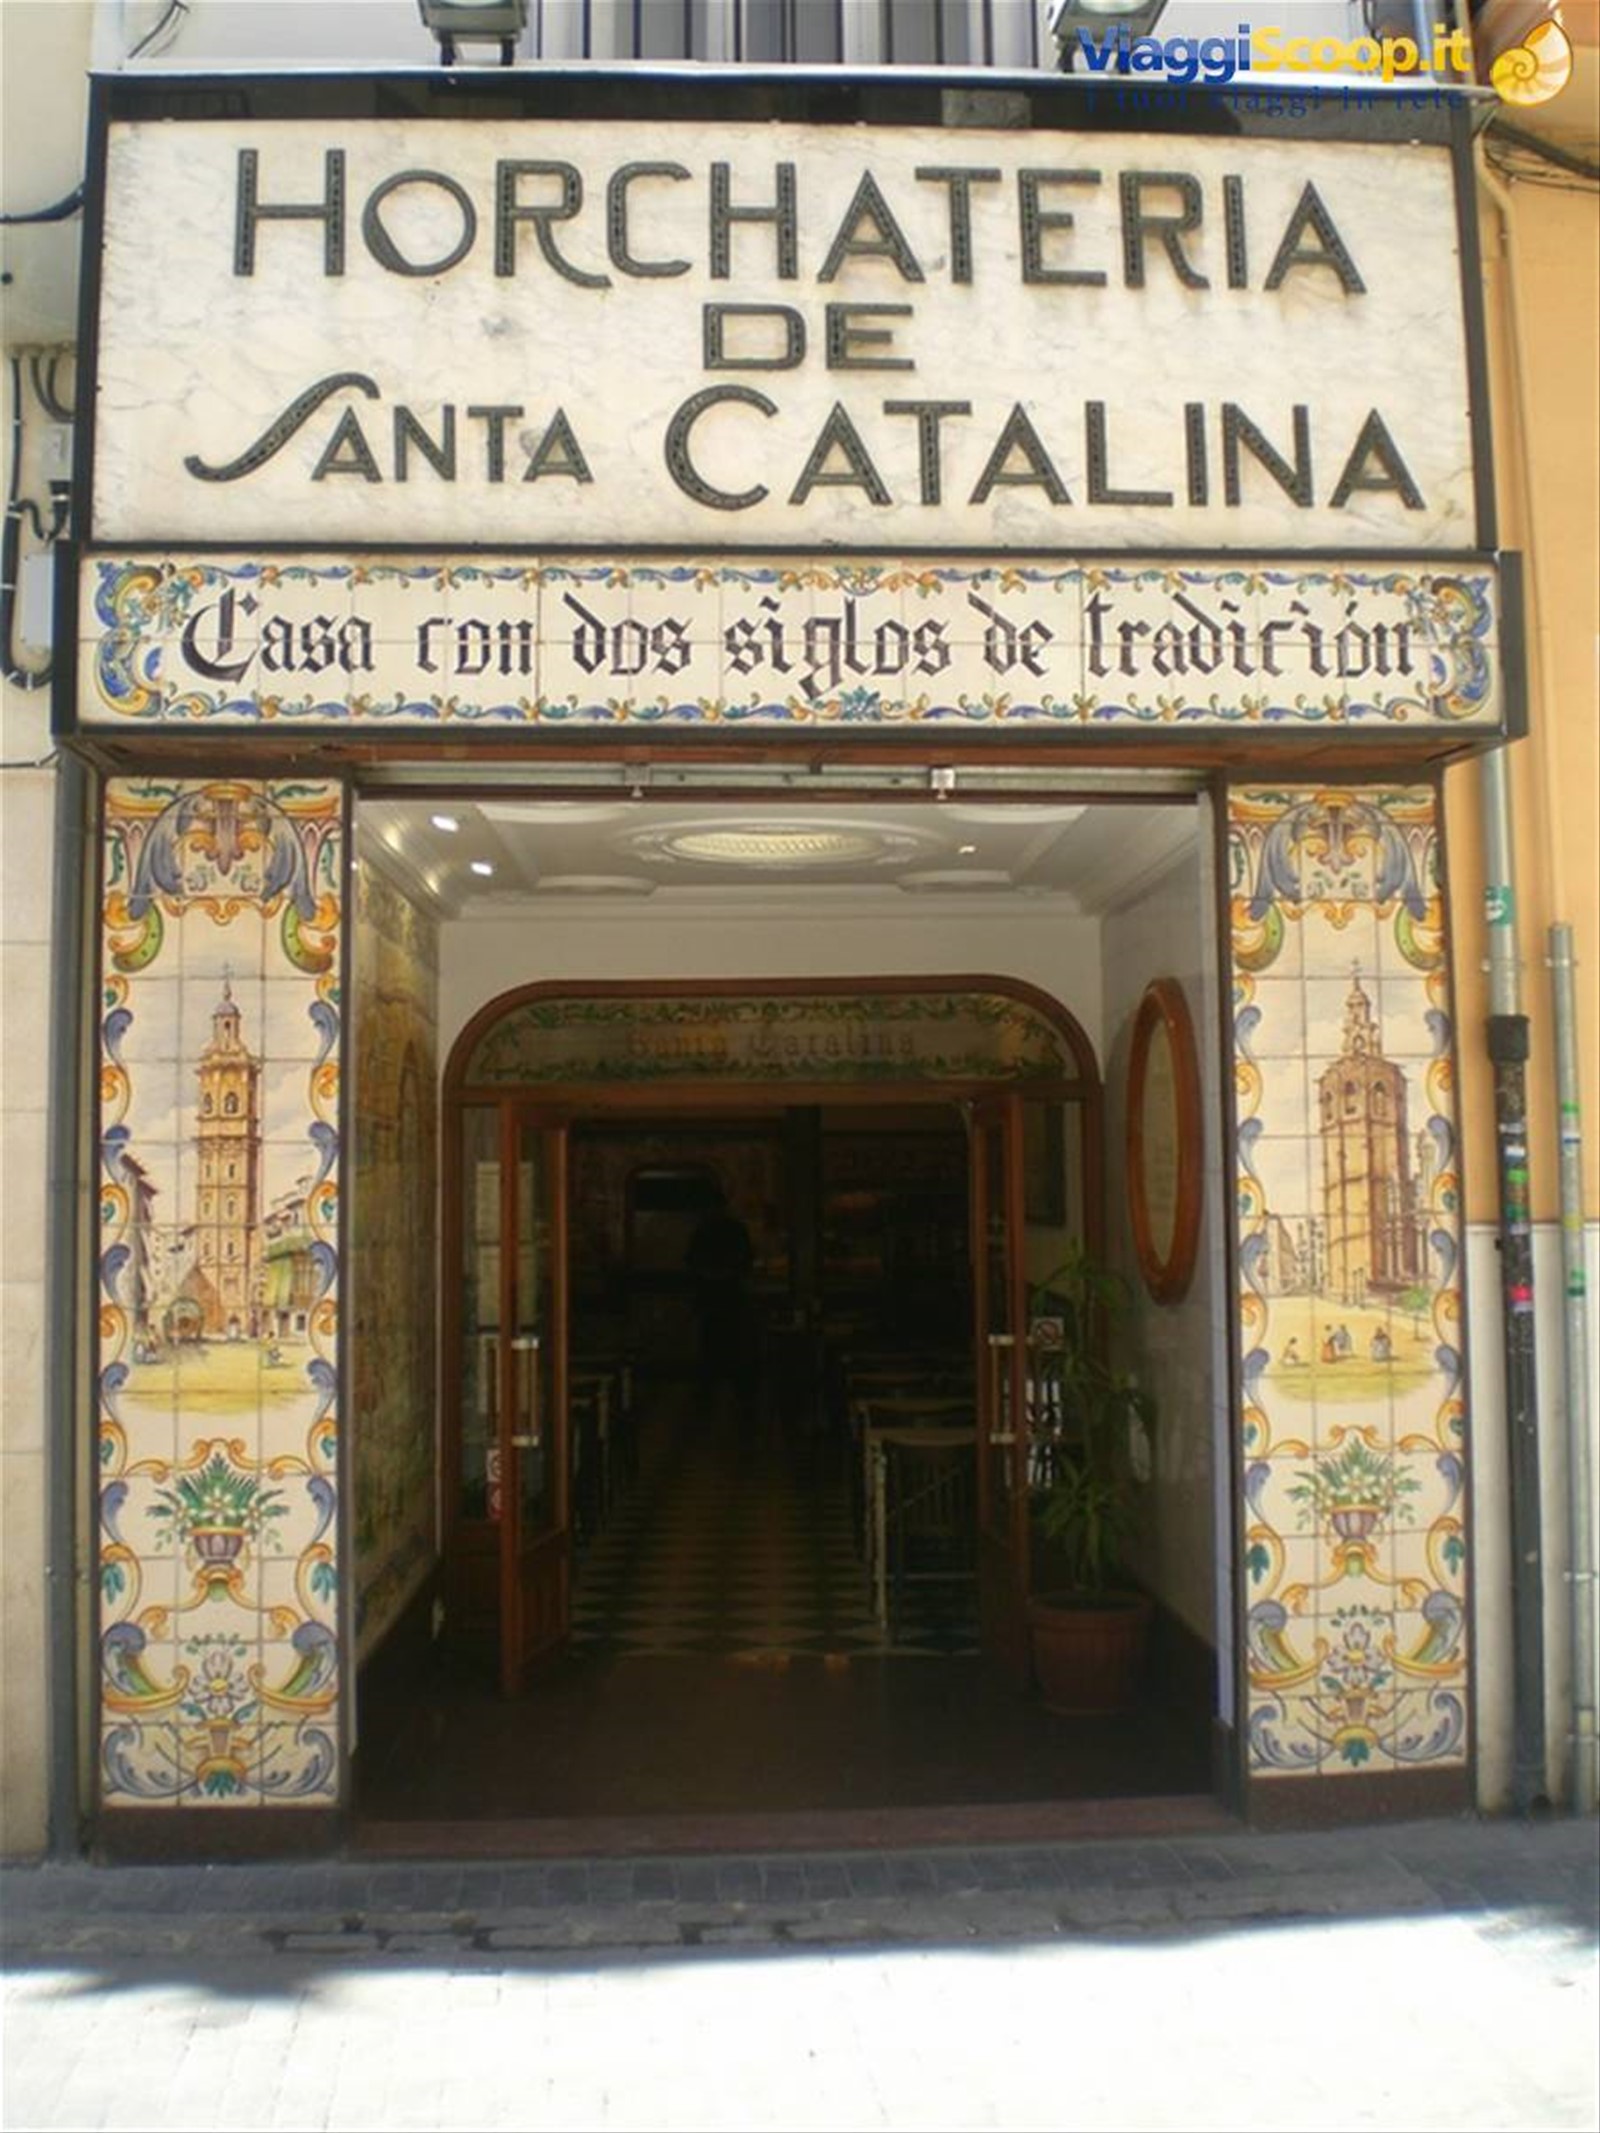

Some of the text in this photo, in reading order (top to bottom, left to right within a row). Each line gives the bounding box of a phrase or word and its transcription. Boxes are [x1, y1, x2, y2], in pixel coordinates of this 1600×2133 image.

[233, 148, 1366, 294] HORCHATERIA
[703, 302, 915, 371] DE
[184, 372, 1426, 511] SANTA CATALINA
[180, 588, 375, 683] Casa
[417, 617, 533, 676] con
[563, 592, 693, 676] dos
[967, 592, 1055, 676] de
[751, 1026, 916, 1060] Catalina
